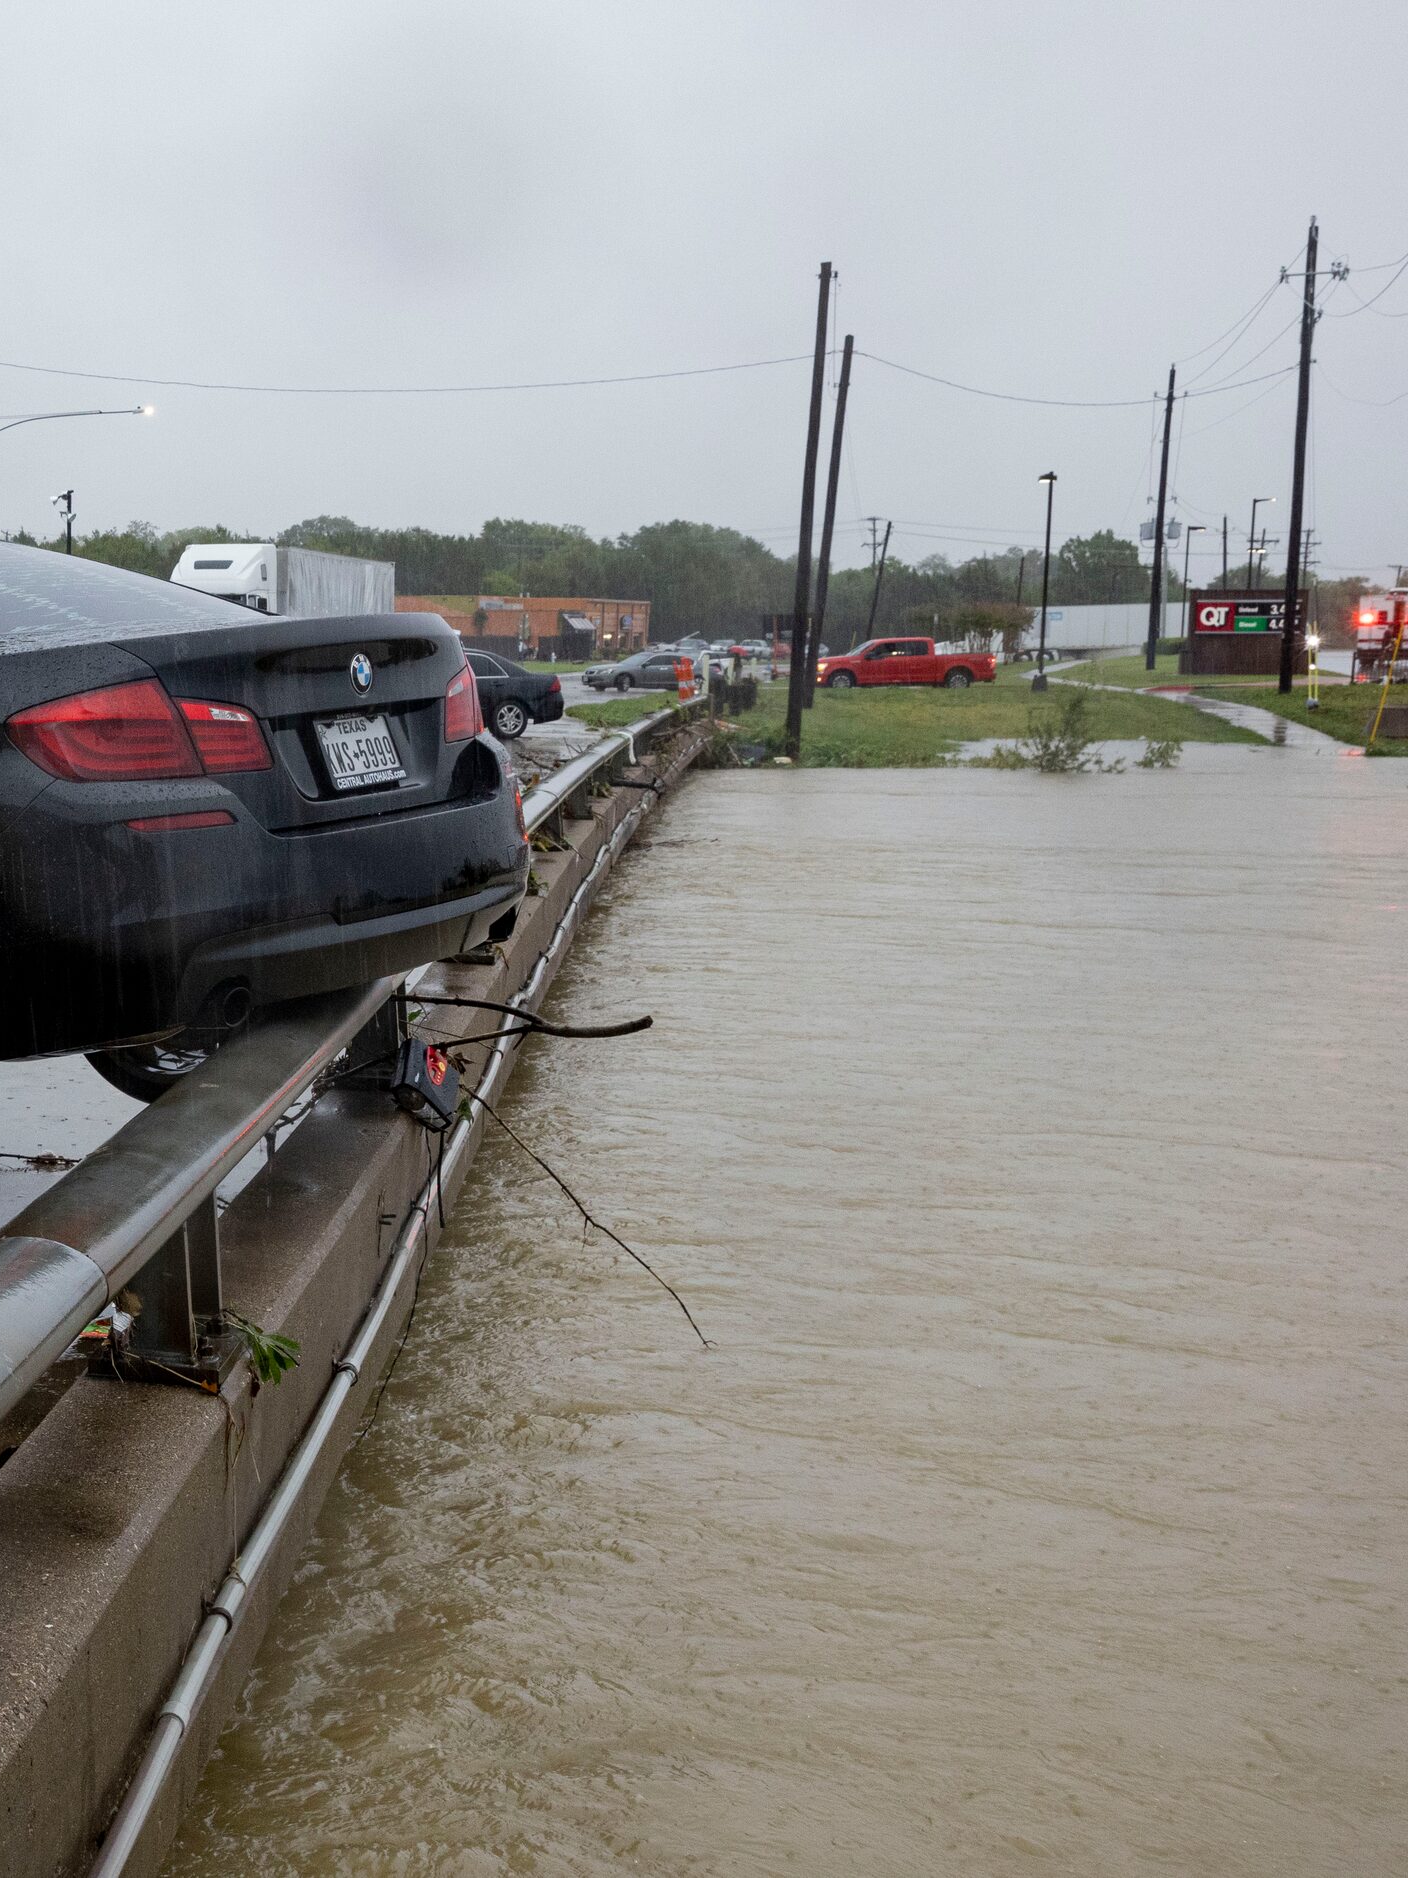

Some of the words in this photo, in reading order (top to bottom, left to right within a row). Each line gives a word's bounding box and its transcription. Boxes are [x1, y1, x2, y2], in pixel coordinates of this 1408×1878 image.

[1200, 607, 1229, 627] QT
[337, 720, 367, 734] TEXAS
[337, 777, 364, 789] CENTRAL
[364, 769, 406, 784] AUTOHAUS.com
